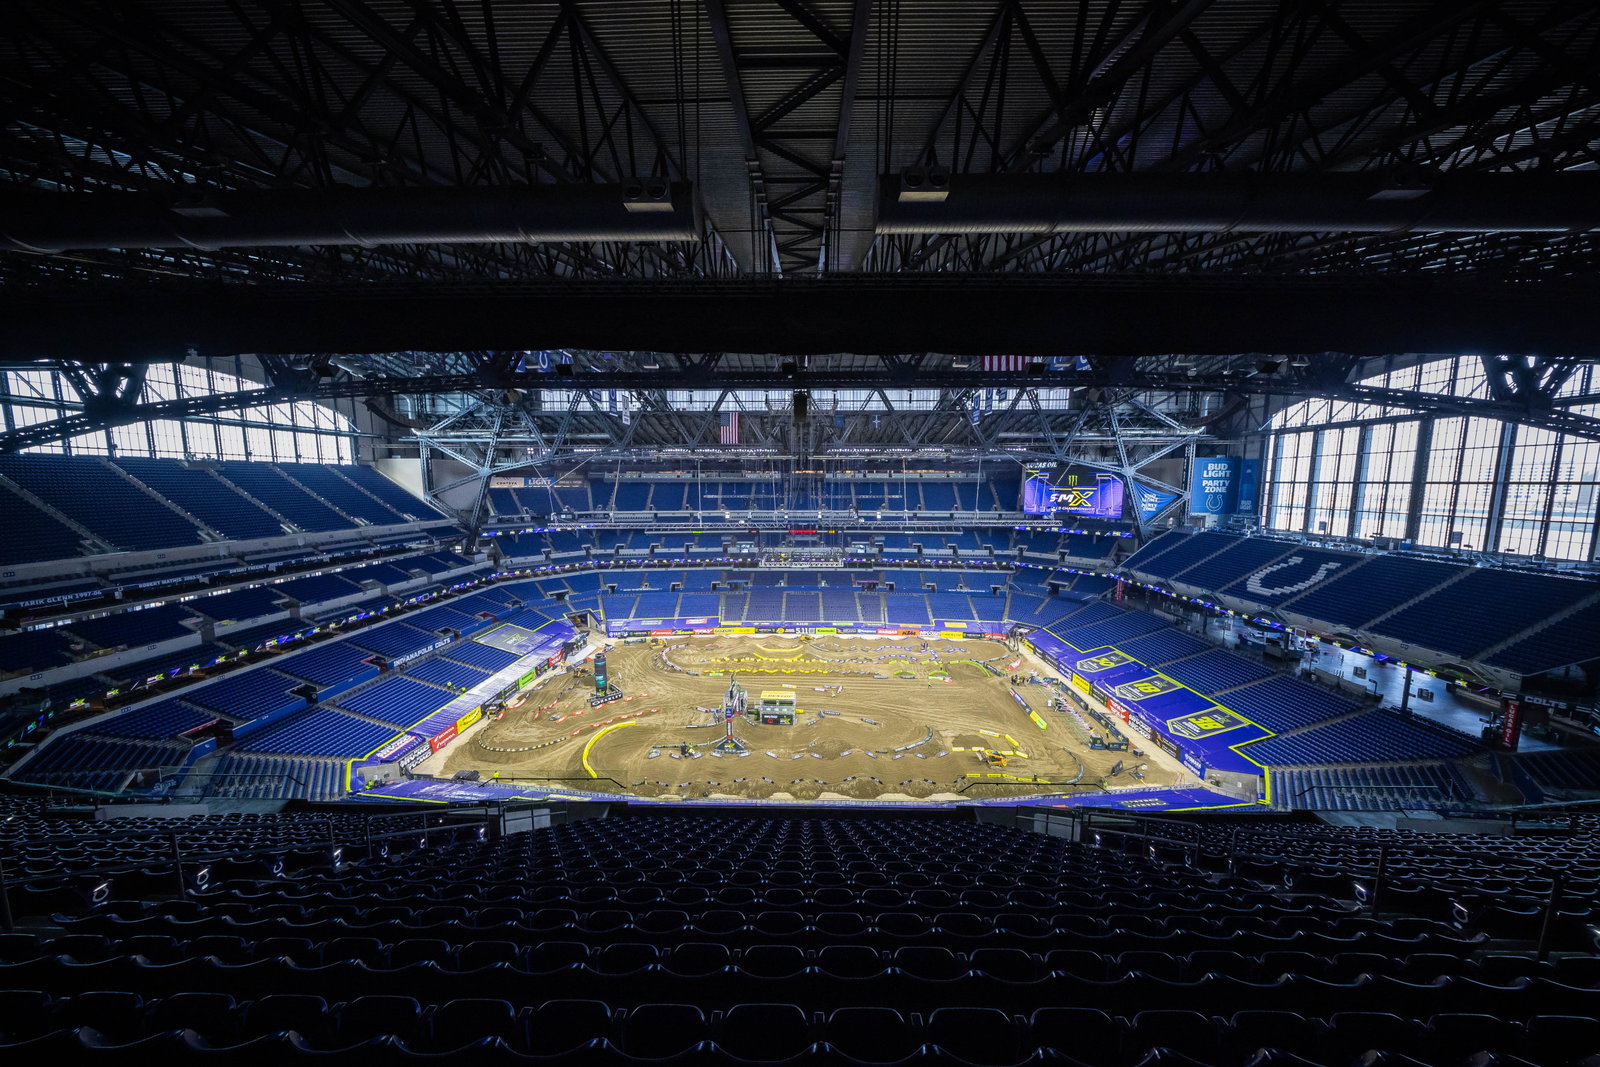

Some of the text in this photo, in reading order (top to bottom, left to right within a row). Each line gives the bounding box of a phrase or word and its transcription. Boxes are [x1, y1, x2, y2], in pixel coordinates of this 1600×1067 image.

[1050, 491, 1094, 506] SMX
[20, 600, 44, 608] TARIK
[394, 638, 450, 667] INDIANAPOLIS COLTS
[1133, 682, 1160, 693] 18
[1524, 696, 1567, 709] COLTS
[1188, 716, 1226, 730] 38
[1507, 705, 1516, 728] LUCAS
[1504, 728, 1512, 743] OIL
